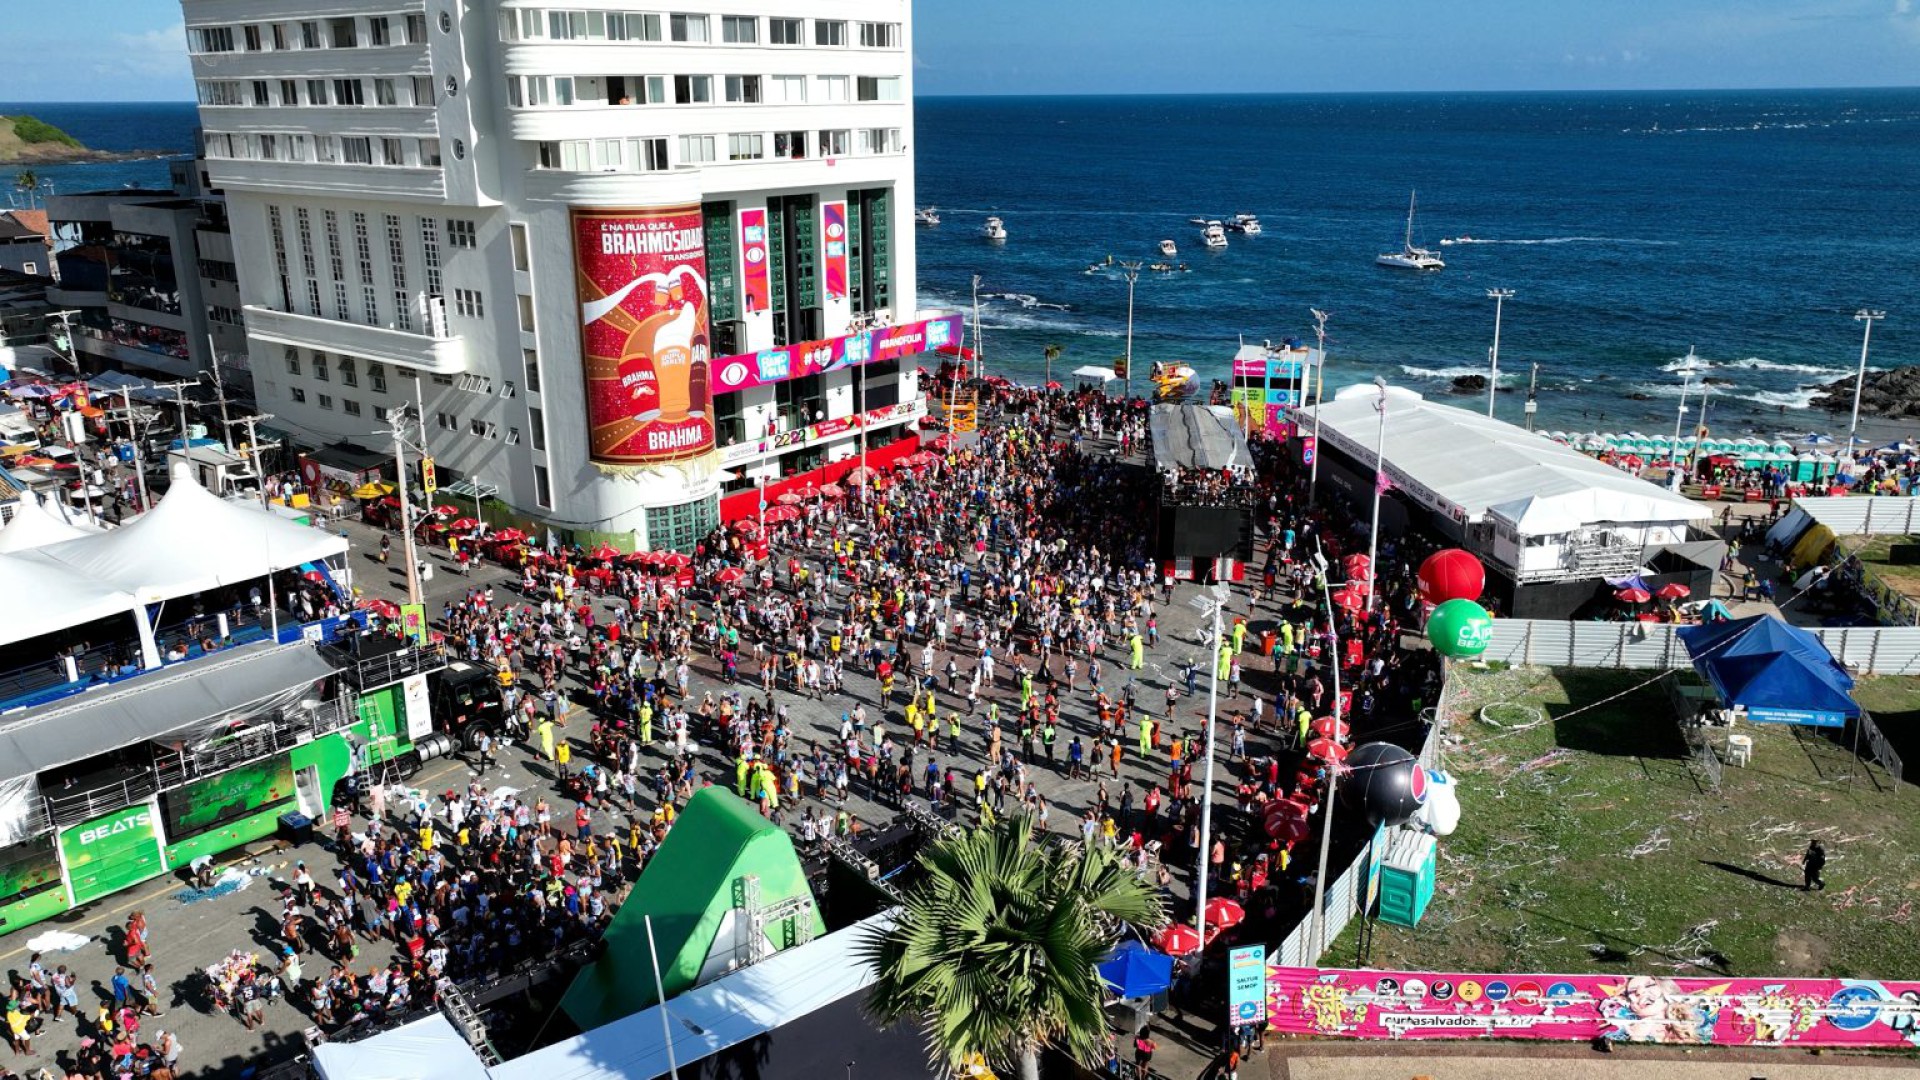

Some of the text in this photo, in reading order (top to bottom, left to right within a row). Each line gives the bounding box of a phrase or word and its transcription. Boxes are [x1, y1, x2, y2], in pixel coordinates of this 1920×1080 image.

[610, 223, 623, 231] NA
[625, 223, 647, 231] RUA
[648, 222, 667, 230] QUE
[879, 333, 922, 349] #BANDFOLIA
[622, 370, 655, 388] BRAHMA
[649, 425, 702, 450] BRAHMA
[80, 813, 150, 845] BEATS
